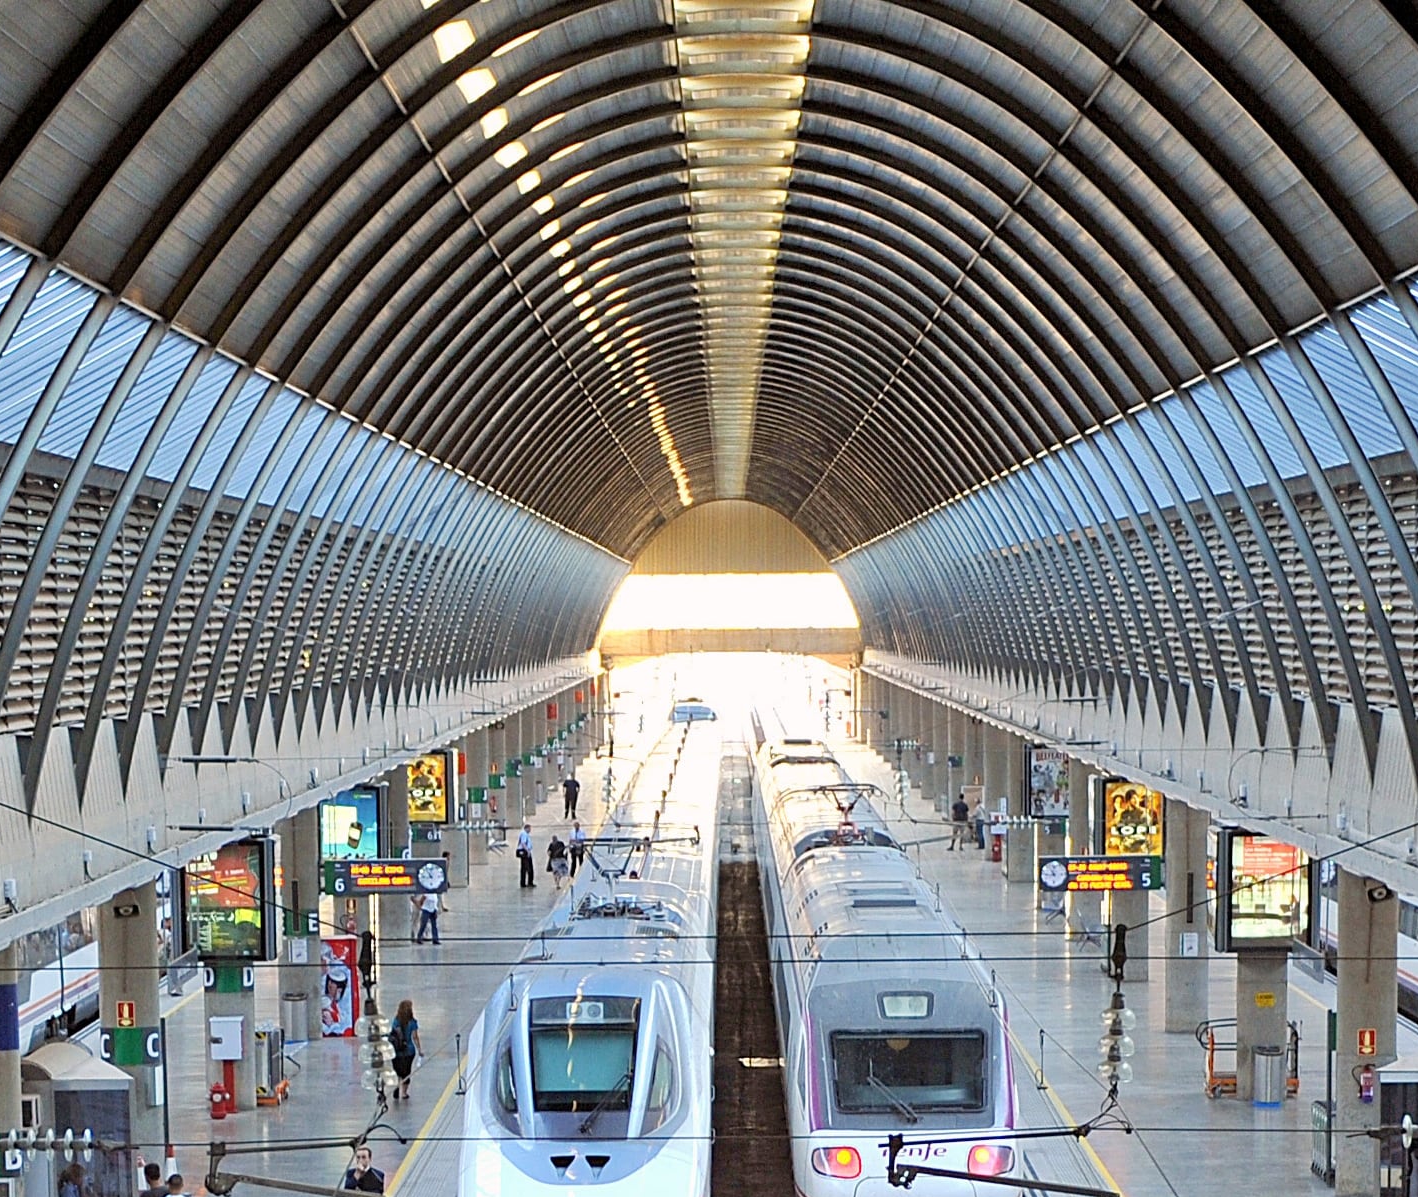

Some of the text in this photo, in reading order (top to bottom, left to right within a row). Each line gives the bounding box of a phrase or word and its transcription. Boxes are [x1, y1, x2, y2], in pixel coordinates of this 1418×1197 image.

[334, 878, 345, 891] 6
[1141, 873, 1150, 887] 5
[204, 967, 214, 987] D
[243, 967, 254, 987] D
[101, 1034, 111, 1058] C
[147, 1033, 159, 1058] C
